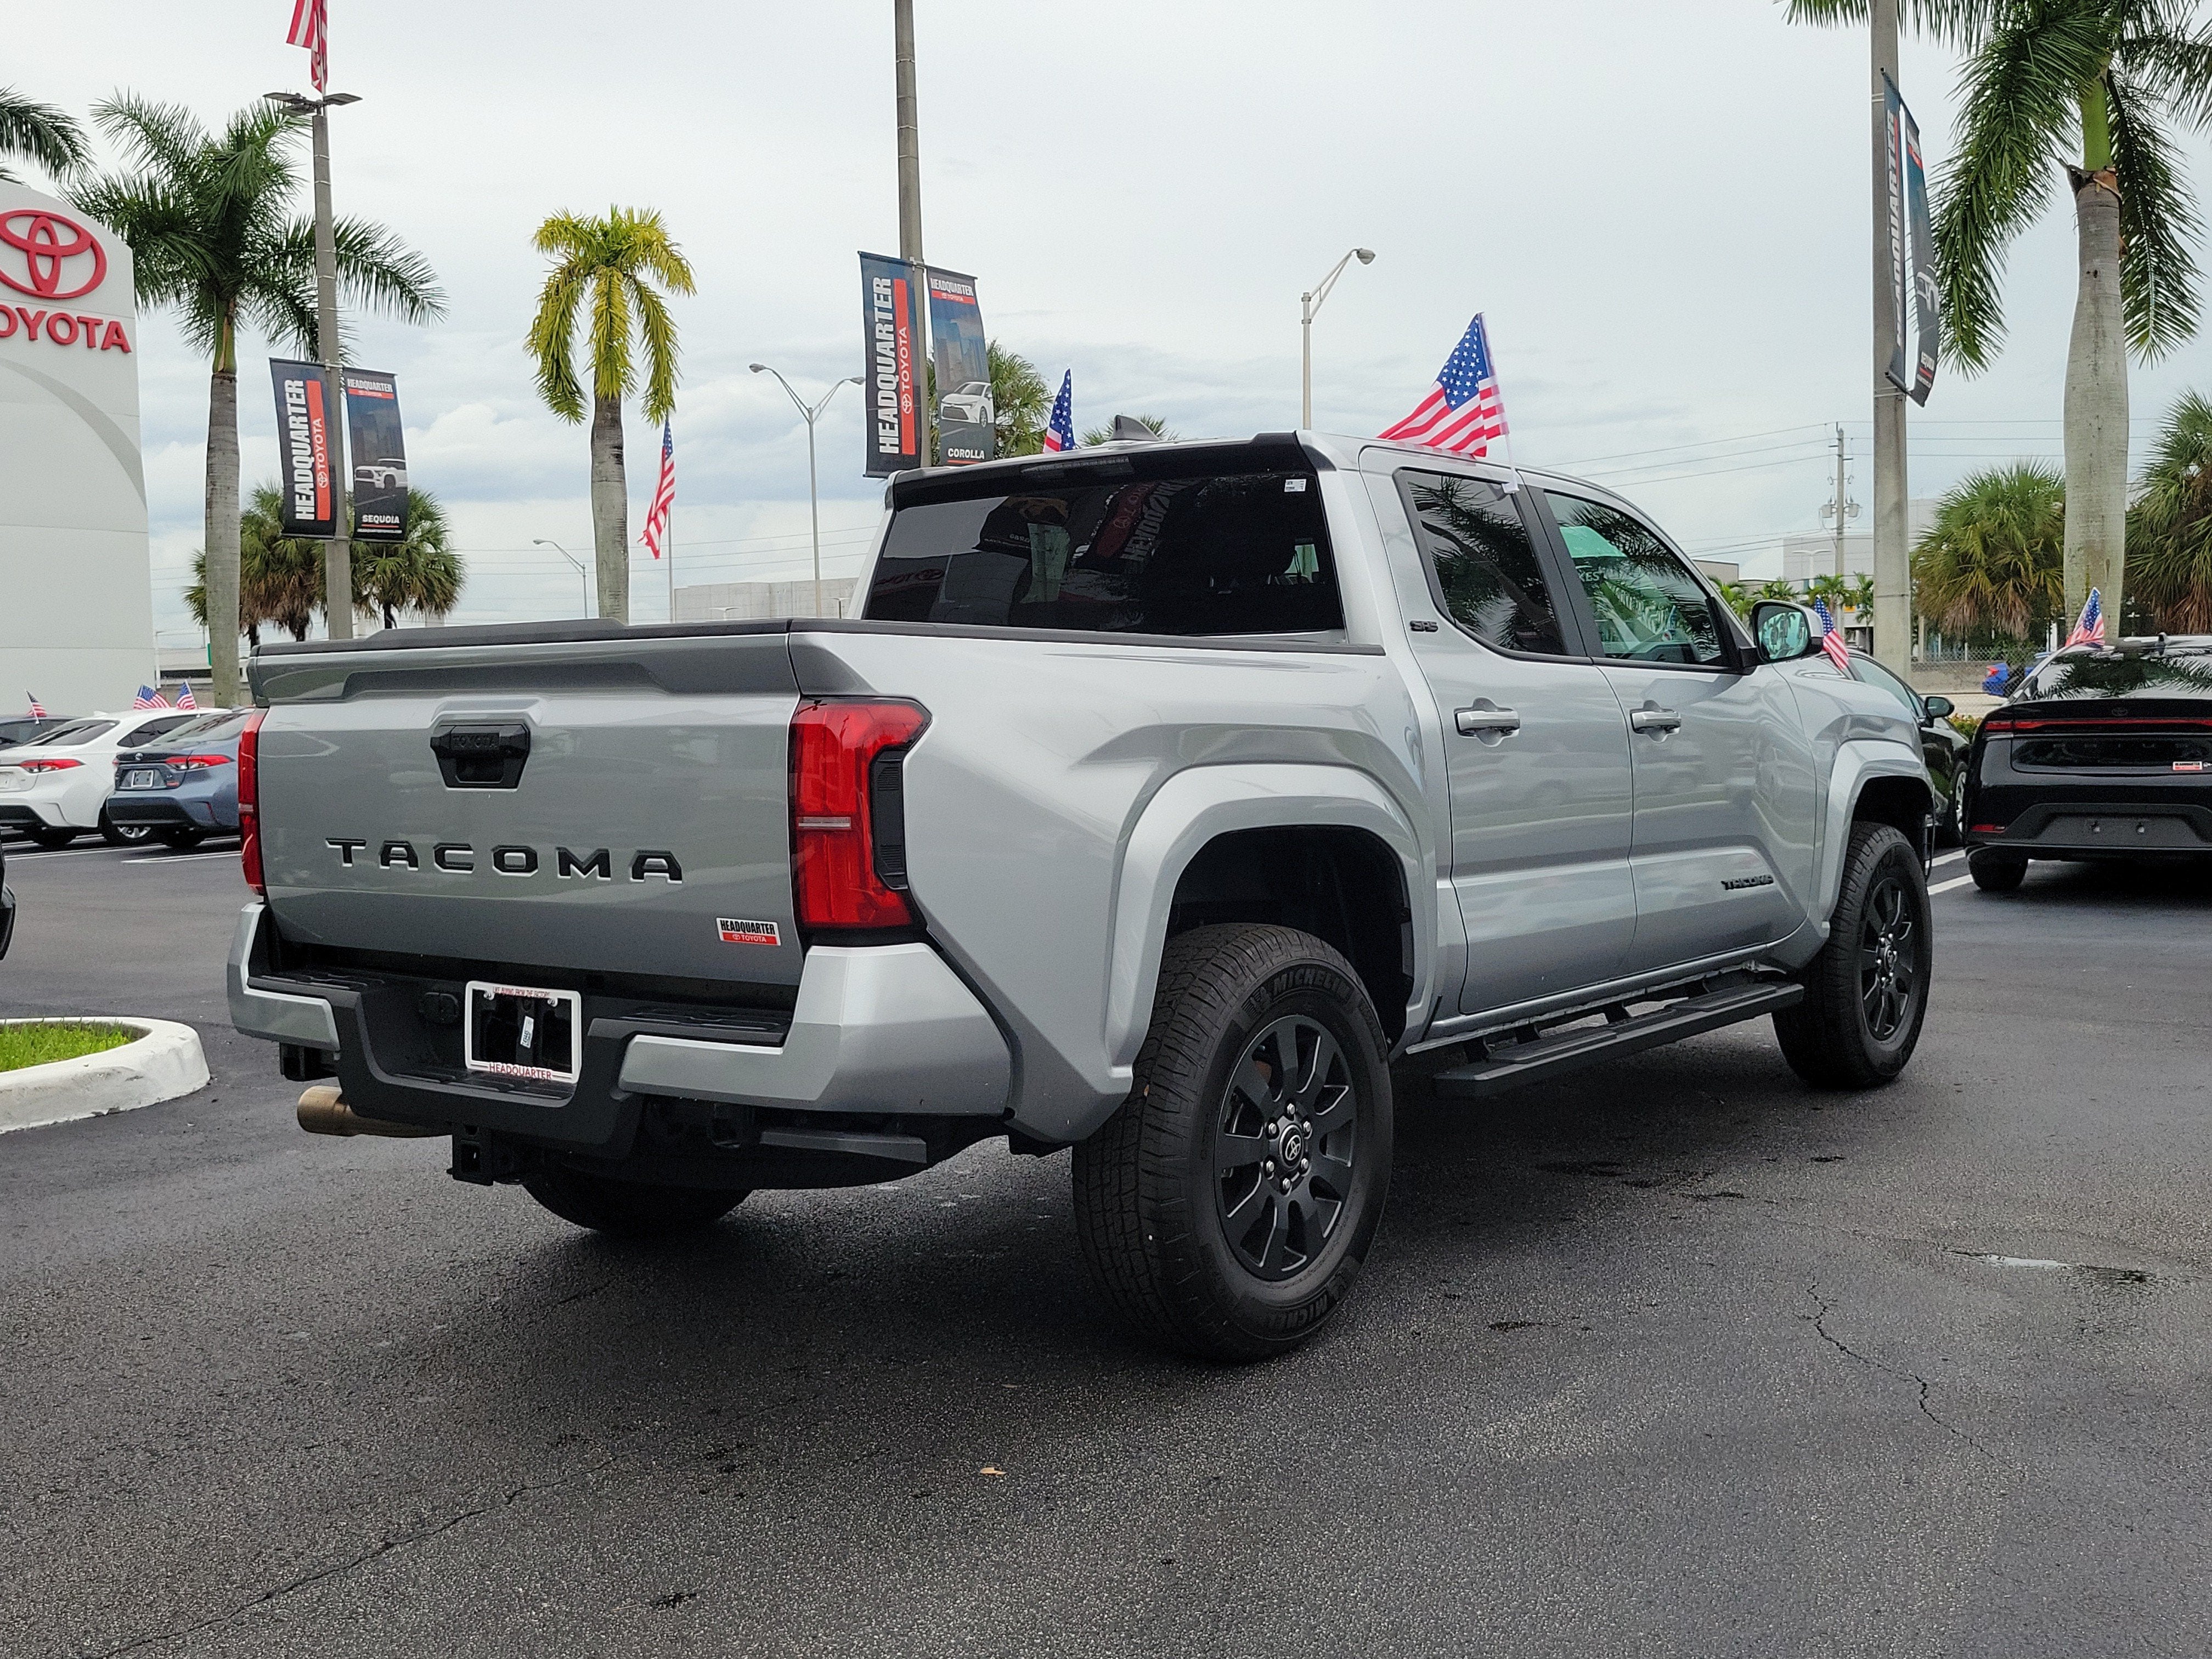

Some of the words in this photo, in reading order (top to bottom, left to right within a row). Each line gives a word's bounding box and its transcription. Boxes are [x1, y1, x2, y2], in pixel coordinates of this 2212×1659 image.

[930, 278, 974, 296] HEADQUARTER
[872, 277, 900, 454] HEADQUARTER
[897, 326, 911, 392] TOYOTA
[347, 378, 393, 392] HEADQUARTER
[284, 379, 315, 521] HEADQUARTER
[313, 417, 326, 470] TOYOTA
[947, 447, 985, 460] COROLLA
[362, 514, 400, 524] SEQUOIA
[1410, 620, 1438, 633] SR5
[325, 837, 683, 884] TACOMA
[1721, 874, 1774, 890] TACOMA
[720, 919, 776, 935] HEADQUARTER
[741, 934, 767, 943] TOYOTA
[1273, 968, 1351, 1000] MICHELIN
[489, 1063, 552, 1080] HEADQUARTER
